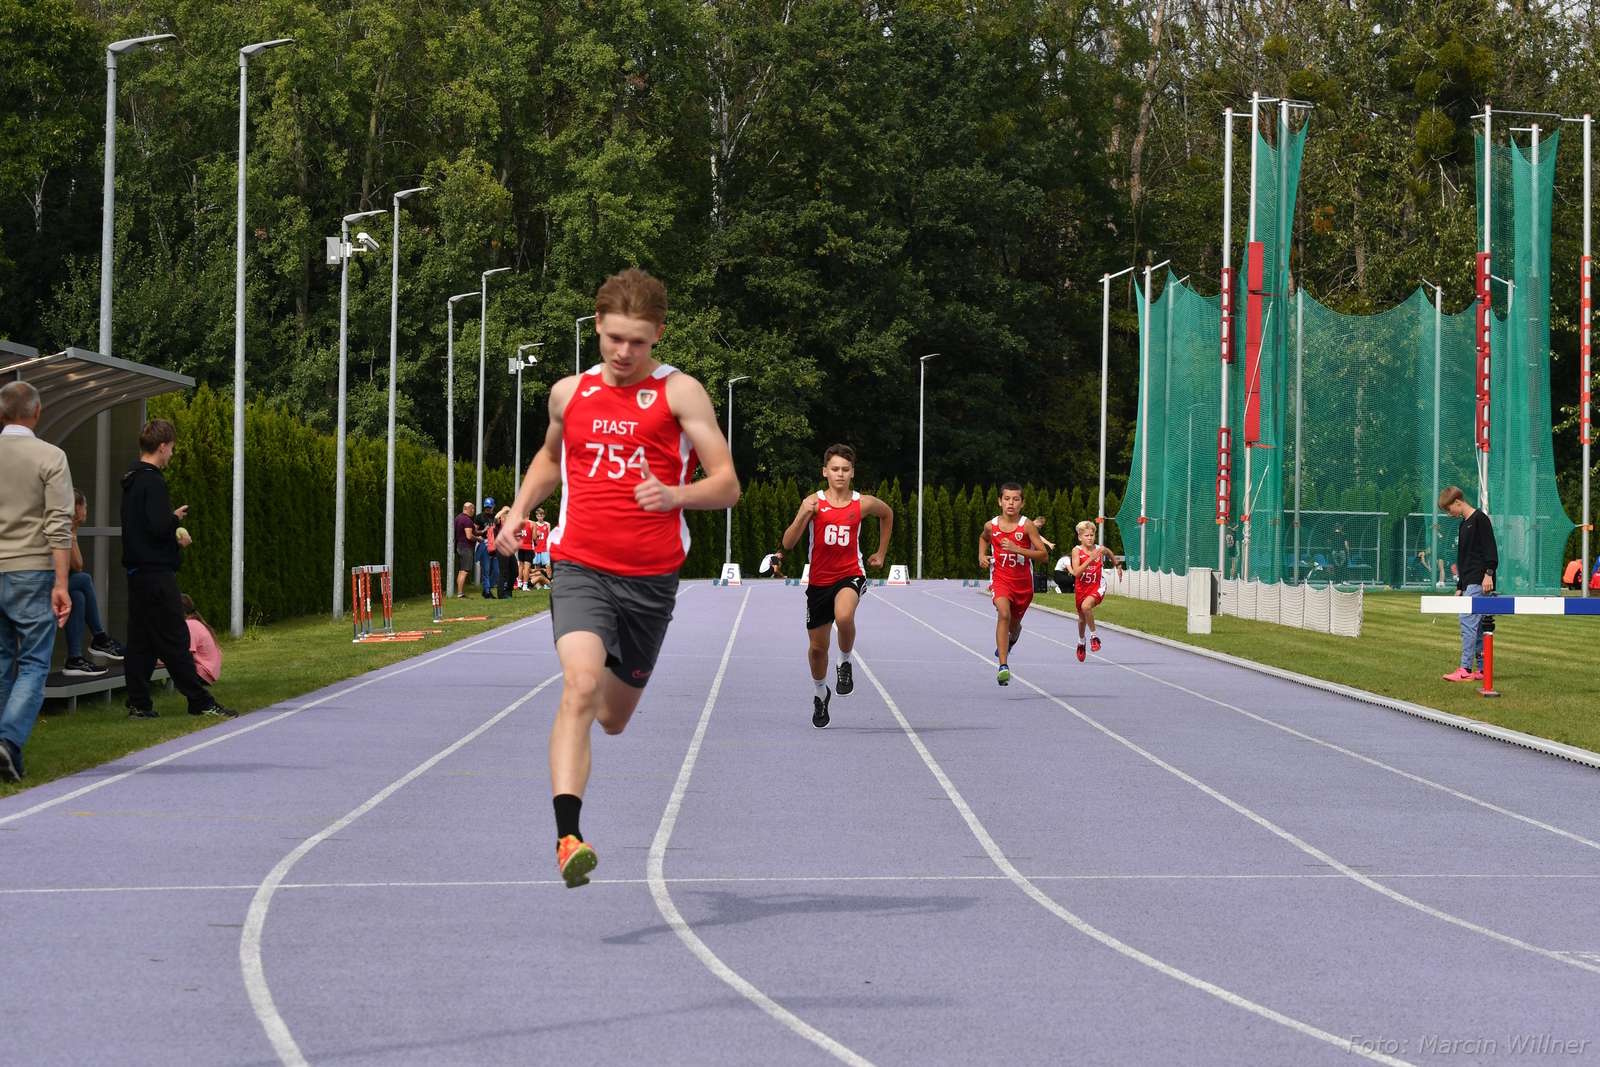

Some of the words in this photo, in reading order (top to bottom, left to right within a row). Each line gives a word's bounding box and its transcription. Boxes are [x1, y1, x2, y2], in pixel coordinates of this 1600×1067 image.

[592, 419, 639, 435] PIAST
[585, 442, 648, 480] 754
[824, 524, 851, 547] 65
[726, 567, 735, 580] 5
[893, 568, 901, 580] 3
